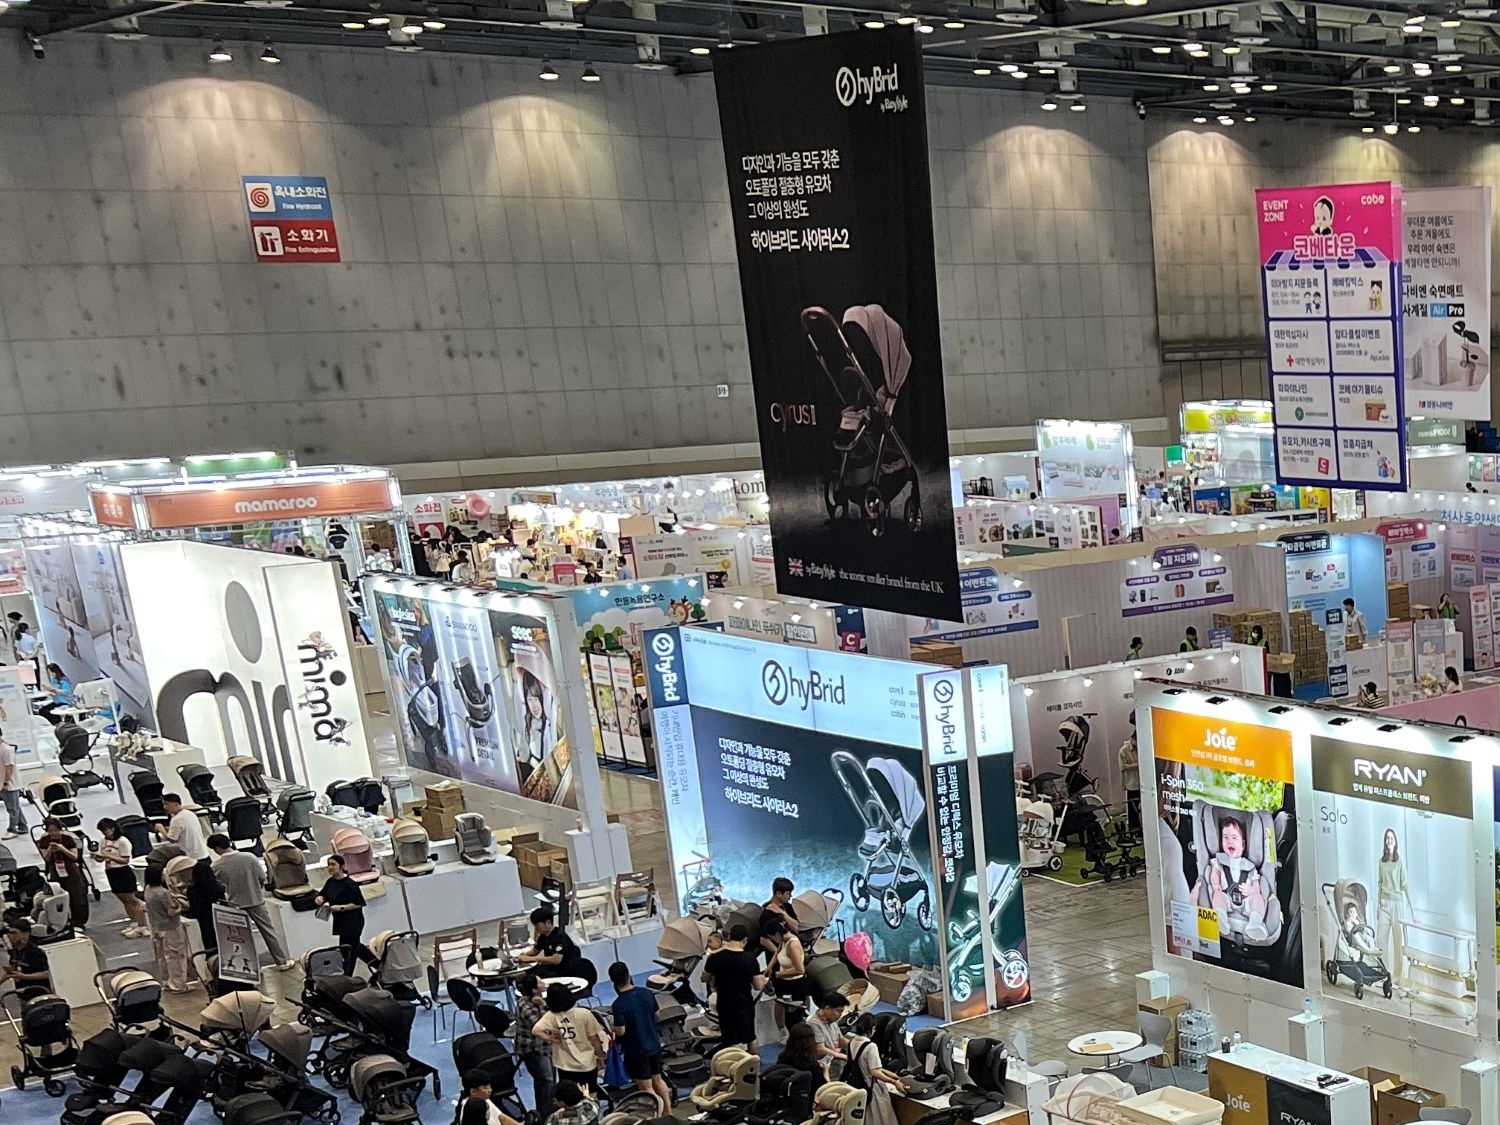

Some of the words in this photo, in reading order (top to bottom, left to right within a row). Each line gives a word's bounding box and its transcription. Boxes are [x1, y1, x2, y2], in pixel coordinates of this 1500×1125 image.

[856, 63, 898, 105] hyBrid
[742, 153, 775, 174] 디자인과
[776, 151, 801, 172] 기능을
[802, 151, 820, 171] 모두
[821, 149, 840, 170] 갖춘
[274, 185, 327, 198] 옥내소화전
[745, 177, 778, 197] 오토폴딩
[778, 175, 804, 196] 절충형
[805, 173, 832, 194] 유모차
[1263, 200, 1288, 211] EVENT
[1360, 194, 1385, 205] cobe
[748, 203, 757, 219] 그
[757, 200, 783, 220] 이상의
[783, 199, 809, 219] 완성도
[1264, 211, 1285, 222] ZONE
[287, 229, 328, 242] 소화기
[751, 228, 800, 252] 하이브리드
[801, 227, 849, 251] 사이러스2
[1294, 233, 1355, 260] 코베타운
[1421, 243, 1435, 255] 아이
[1429, 284, 1464, 298] 숙면매트
[1432, 304, 1444, 315] Air
[1448, 305, 1464, 315] Pro
[234, 496, 317, 513] mamaroo
[414, 502, 441, 514] 소화전
[904, 577, 920, 591] from
[921, 580, 931, 592] the
[931, 580, 944, 594] UK
[655, 656, 680, 702] hyBrid
[788, 666, 846, 711] hyBrid
[935, 705, 957, 755] hyBrid
[1203, 727, 1236, 751] Joie
[744, 741, 764, 756] 기능을
[763, 746, 776, 762] 모두
[765, 762, 786, 779] 유모차
[1354, 758, 1422, 787] RYAN
[1161, 773, 1186, 790] i-Spin
[1186, 778, 1205, 792] 360
[724, 786, 764, 809] 하이브리드
[763, 795, 800, 818] 사이러스2
[1162, 790, 1186, 803] mesh
[1320, 805, 1348, 825] Solo
[954, 832, 964, 859] 유모차
[1198, 908, 1218, 923] ADAC
[560, 1026, 576, 1040] 25
[1226, 1093, 1251, 1113] Joie
